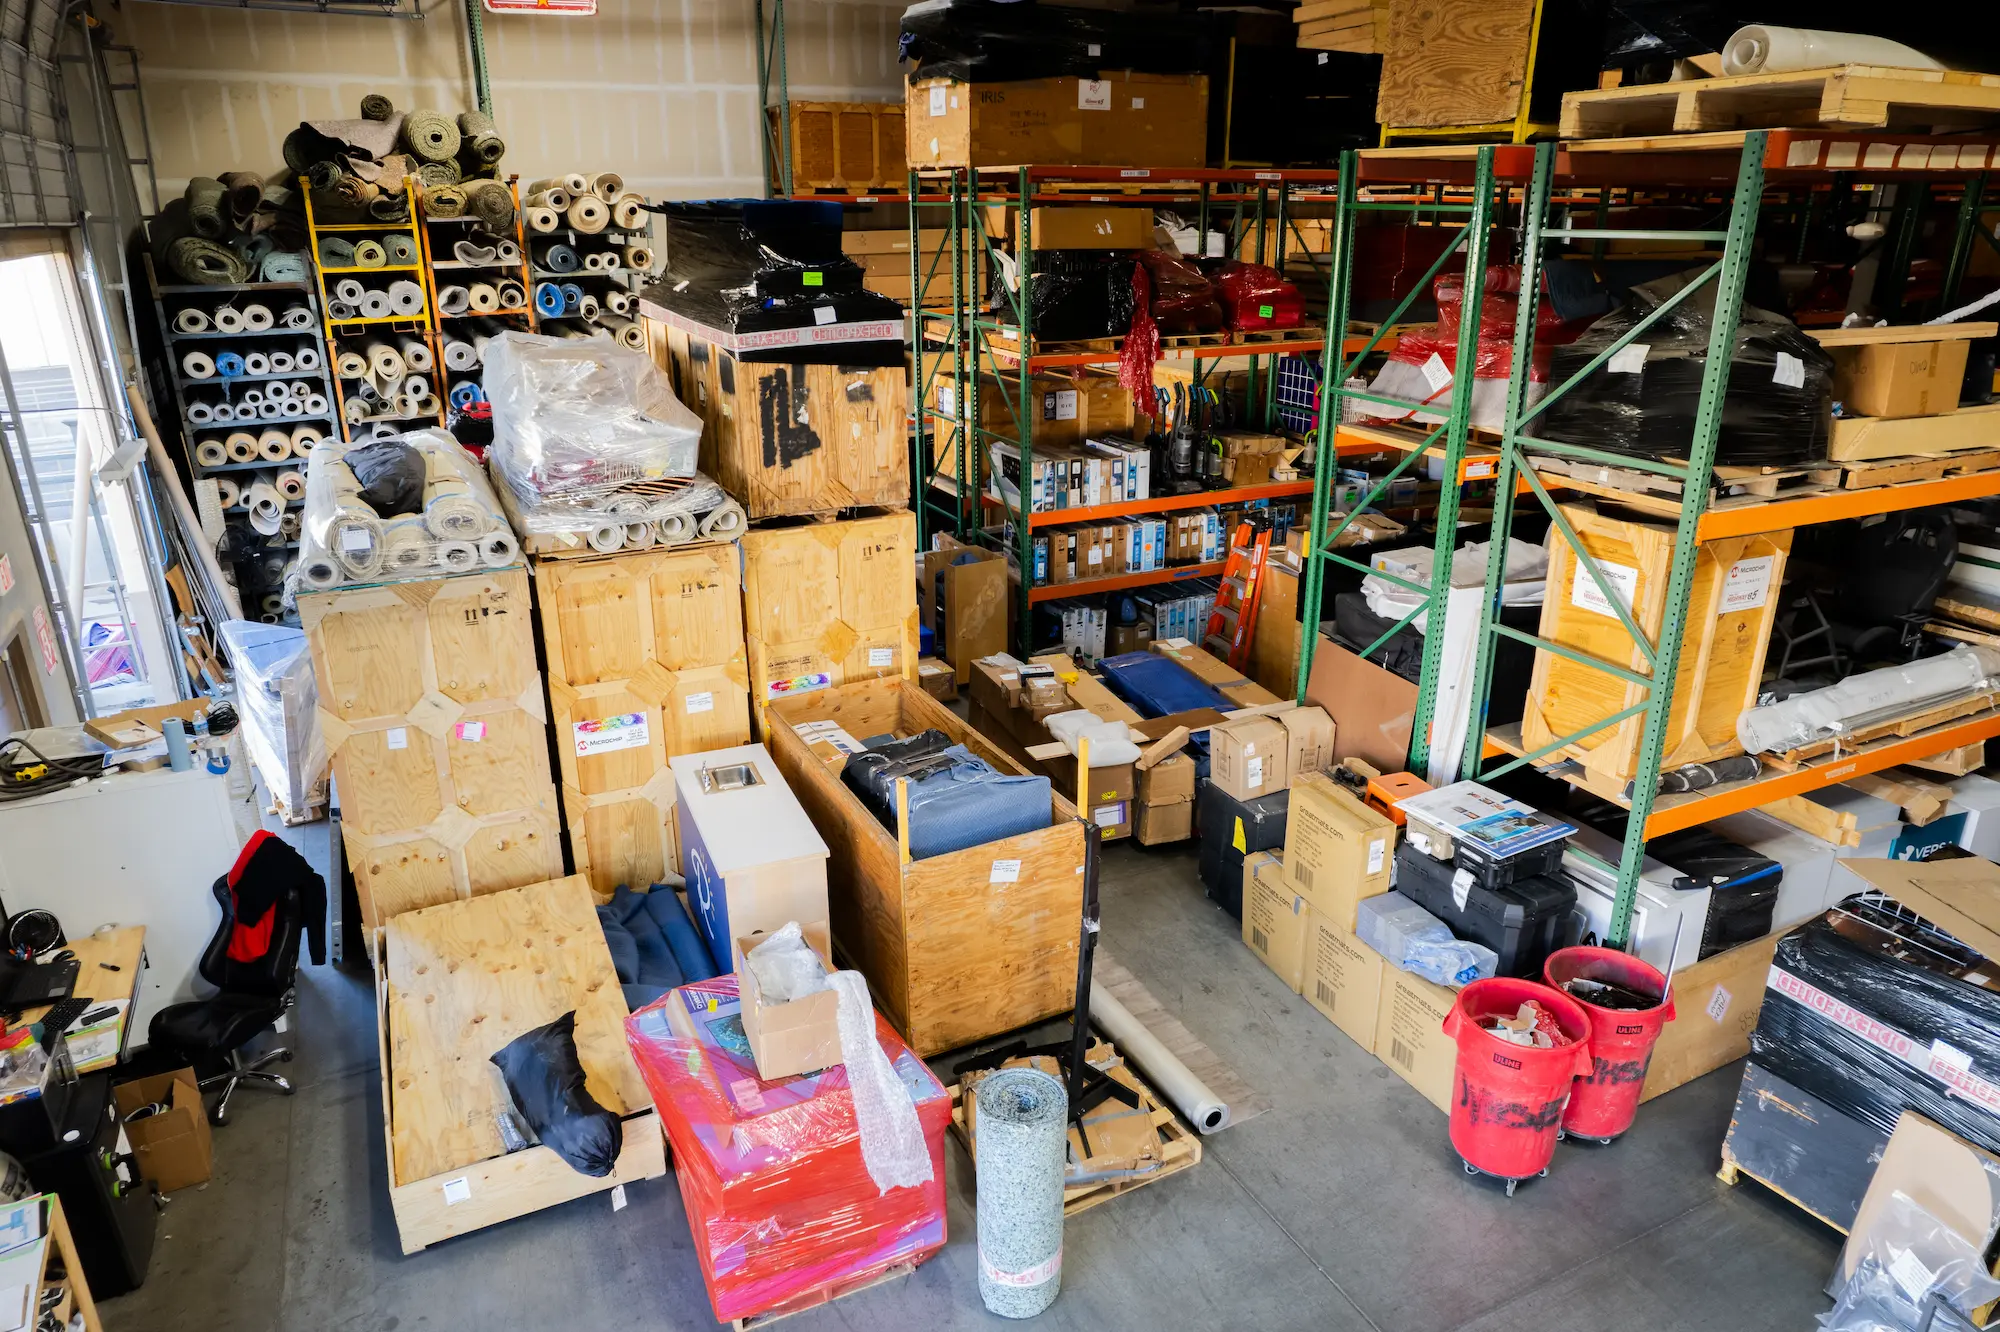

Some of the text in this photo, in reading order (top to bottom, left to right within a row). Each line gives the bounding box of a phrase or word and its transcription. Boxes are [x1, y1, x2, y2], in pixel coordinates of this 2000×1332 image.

[981, 91, 1005, 105] IRIS
[1299, 805, 1344, 841] Greatmats.com
[1319, 924, 1366, 964] Greatmats.com
[1618, 1026, 1642, 1034] ULINE
[1495, 1056, 1521, 1070] ULINE
